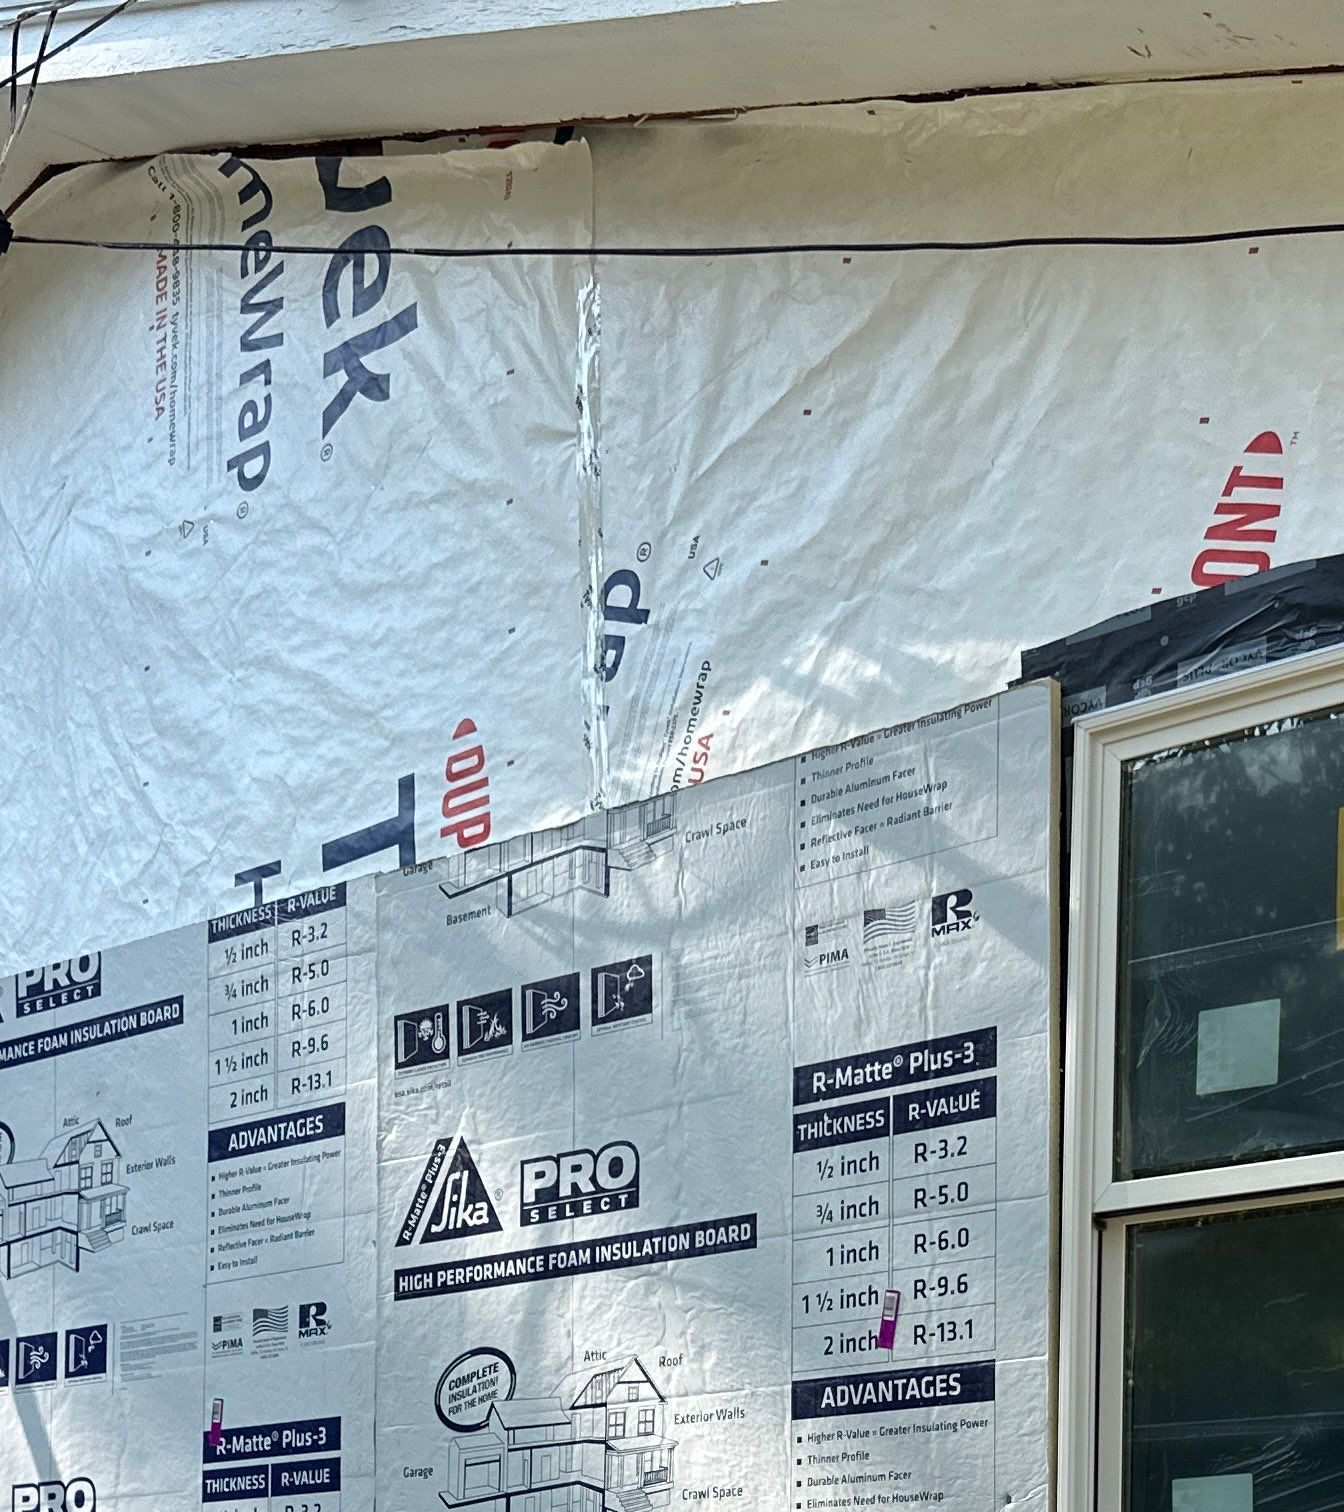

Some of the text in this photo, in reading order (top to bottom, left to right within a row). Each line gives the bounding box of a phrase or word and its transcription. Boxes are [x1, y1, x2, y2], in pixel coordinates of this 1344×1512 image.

[684, 816, 747, 844] Crawl Space
[446, 906, 492, 926] Basement
[241, 923, 328, 960] inch R-3.2
[818, 949, 849, 964] PIMA
[23, 985, 95, 1014] SELECT
[37, 1034, 68, 1054] FOAM
[70, 1017, 137, 1047] INSULATION
[139, 1003, 180, 1030] BOARD
[909, 1043, 975, 1077] Plus-3
[291, 1071, 333, 1095] R-13.1
[228, 1114, 324, 1152] ADVANTAGES
[839, 1150, 880, 1175] inch
[913, 1138, 967, 1163] R-3.2
[431, 1144, 637, 1233] Sika PRO
[529, 1194, 629, 1223] SELECT
[399, 1223, 751, 1292] HIGH PERFORMANCE FOAM INSULATION BOARD
[583, 1348, 607, 1362] Attic
[659, 1353, 683, 1369] Roof
[447, 1361, 500, 1390] COMPLETE
[821, 1373, 962, 1408] ADVANTAGES
[674, 1407, 745, 1425] Exterior Walls
[282, 1427, 327, 1448] Plus-3
[403, 1465, 434, 1480] Garage
